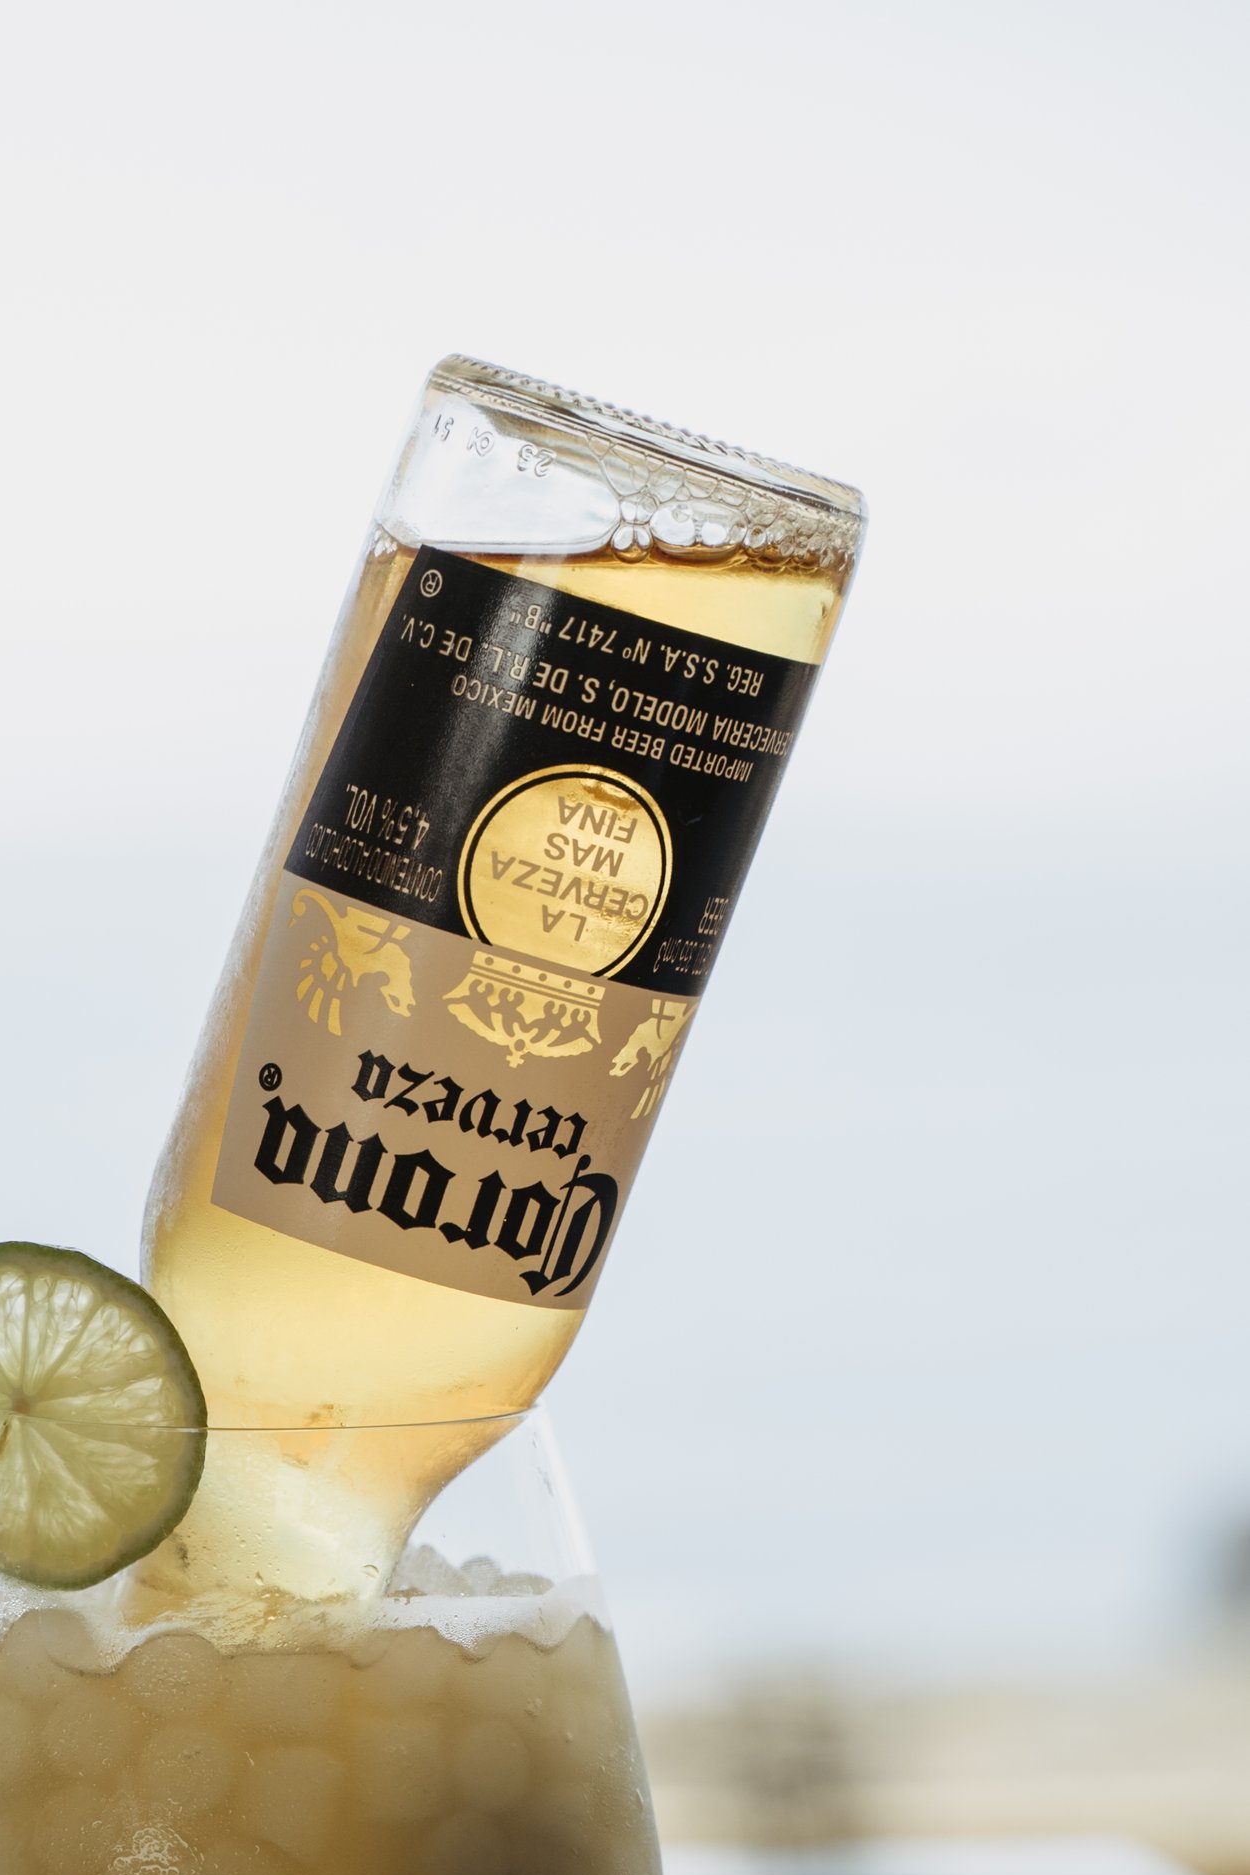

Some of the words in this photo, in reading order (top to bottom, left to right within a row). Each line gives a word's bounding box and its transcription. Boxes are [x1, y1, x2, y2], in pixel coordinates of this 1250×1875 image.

[400, 613, 435, 648] C.V.
[510, 604, 552, 635] "B"
[558, 616, 618, 654] 7417
[439, 630, 473, 662] DE
[482, 642, 531, 681] R.L.
[660, 644, 719, 685] S.S.A.
[452, 674, 537, 720] MEXICO
[532, 661, 569, 695] DE
[578, 673, 600, 704] S.
[726, 664, 765, 697] REG.
[540, 703, 607, 743] FROM
[608, 679, 709, 736] MODELO,
[611, 725, 666, 760] BEER
[669, 743, 754, 783] IMPORTED
[345, 783, 378, 834] VOL.
[557, 795, 639, 844] FINA
[543, 832, 625, 878] MAS
[490, 850, 650, 922] CERVEZA
[541, 904, 588, 943] LA
[350, 1049, 588, 1159] cerveza
[253, 1095, 619, 1297] Corona
